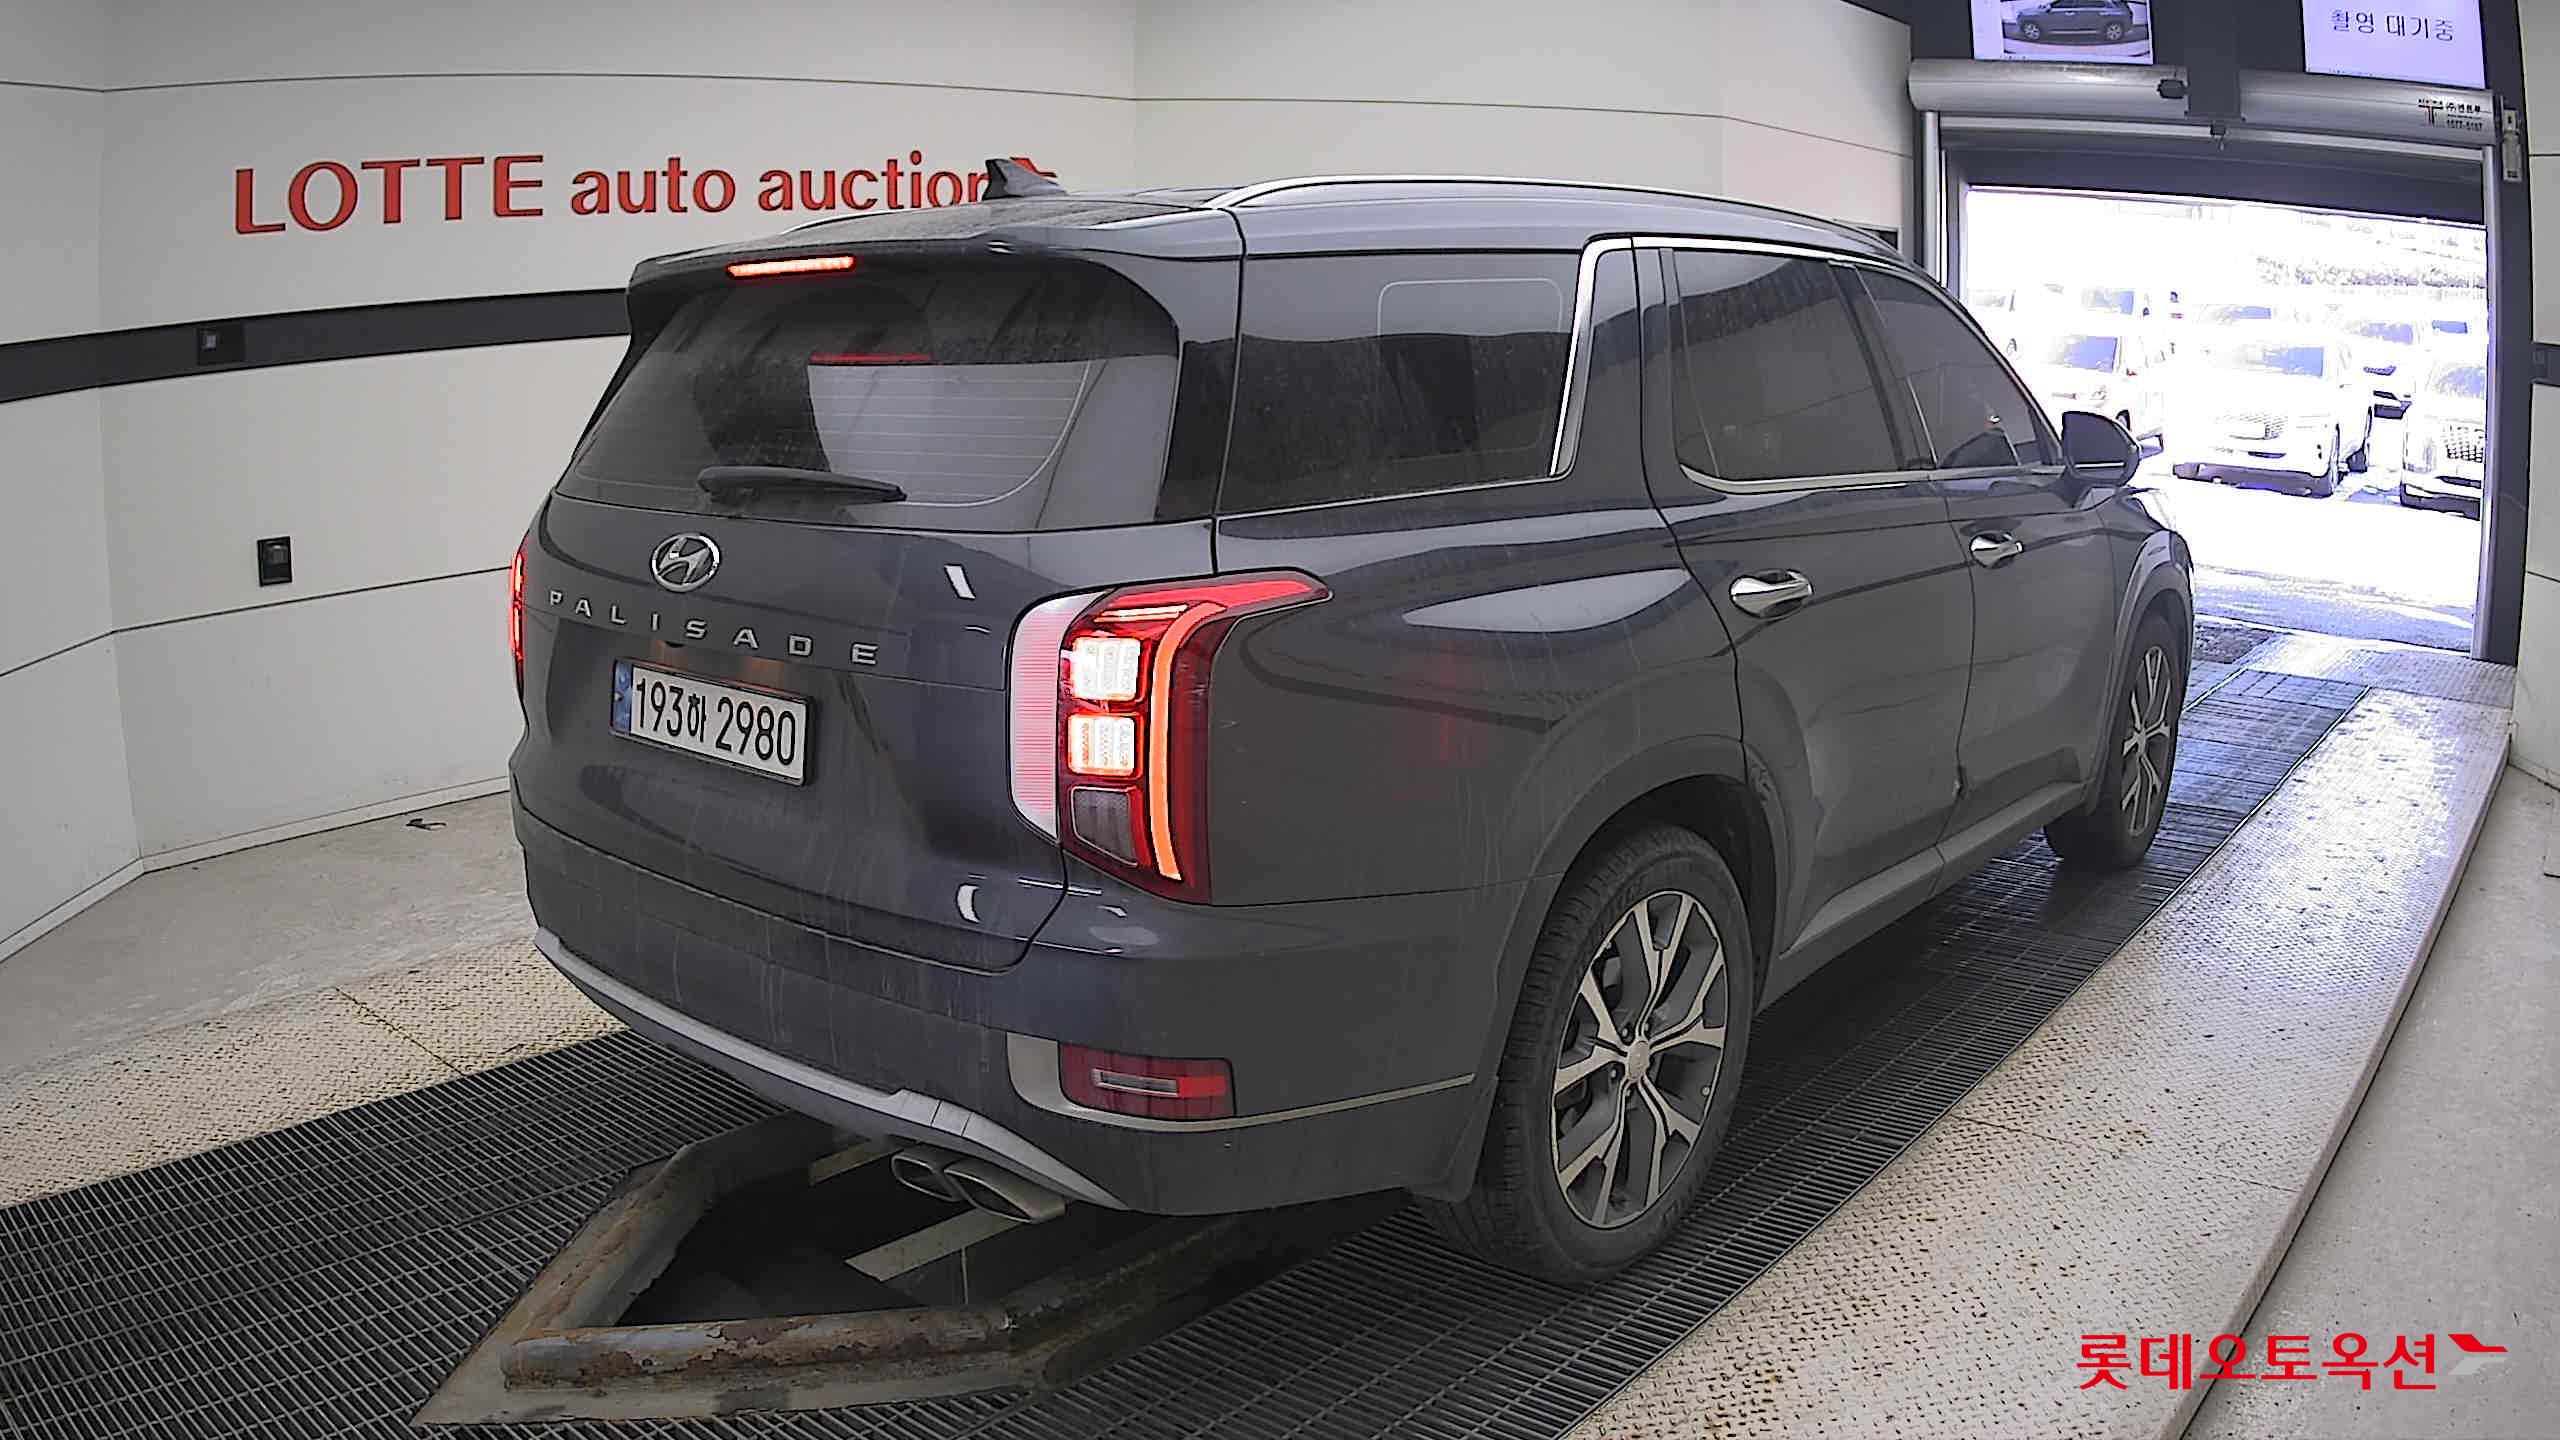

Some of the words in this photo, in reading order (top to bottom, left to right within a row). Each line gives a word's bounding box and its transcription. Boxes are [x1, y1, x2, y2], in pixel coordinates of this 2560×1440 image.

[2331, 9, 2375, 34] 촬영
[2386, 15, 2454, 42] 대기중
[234, 154, 544, 235] LOTTE
[570, 156, 737, 216] auto
[549, 590, 879, 666] PALISADE
[636, 678, 707, 743] 193하
[715, 696, 796, 766] 2980
